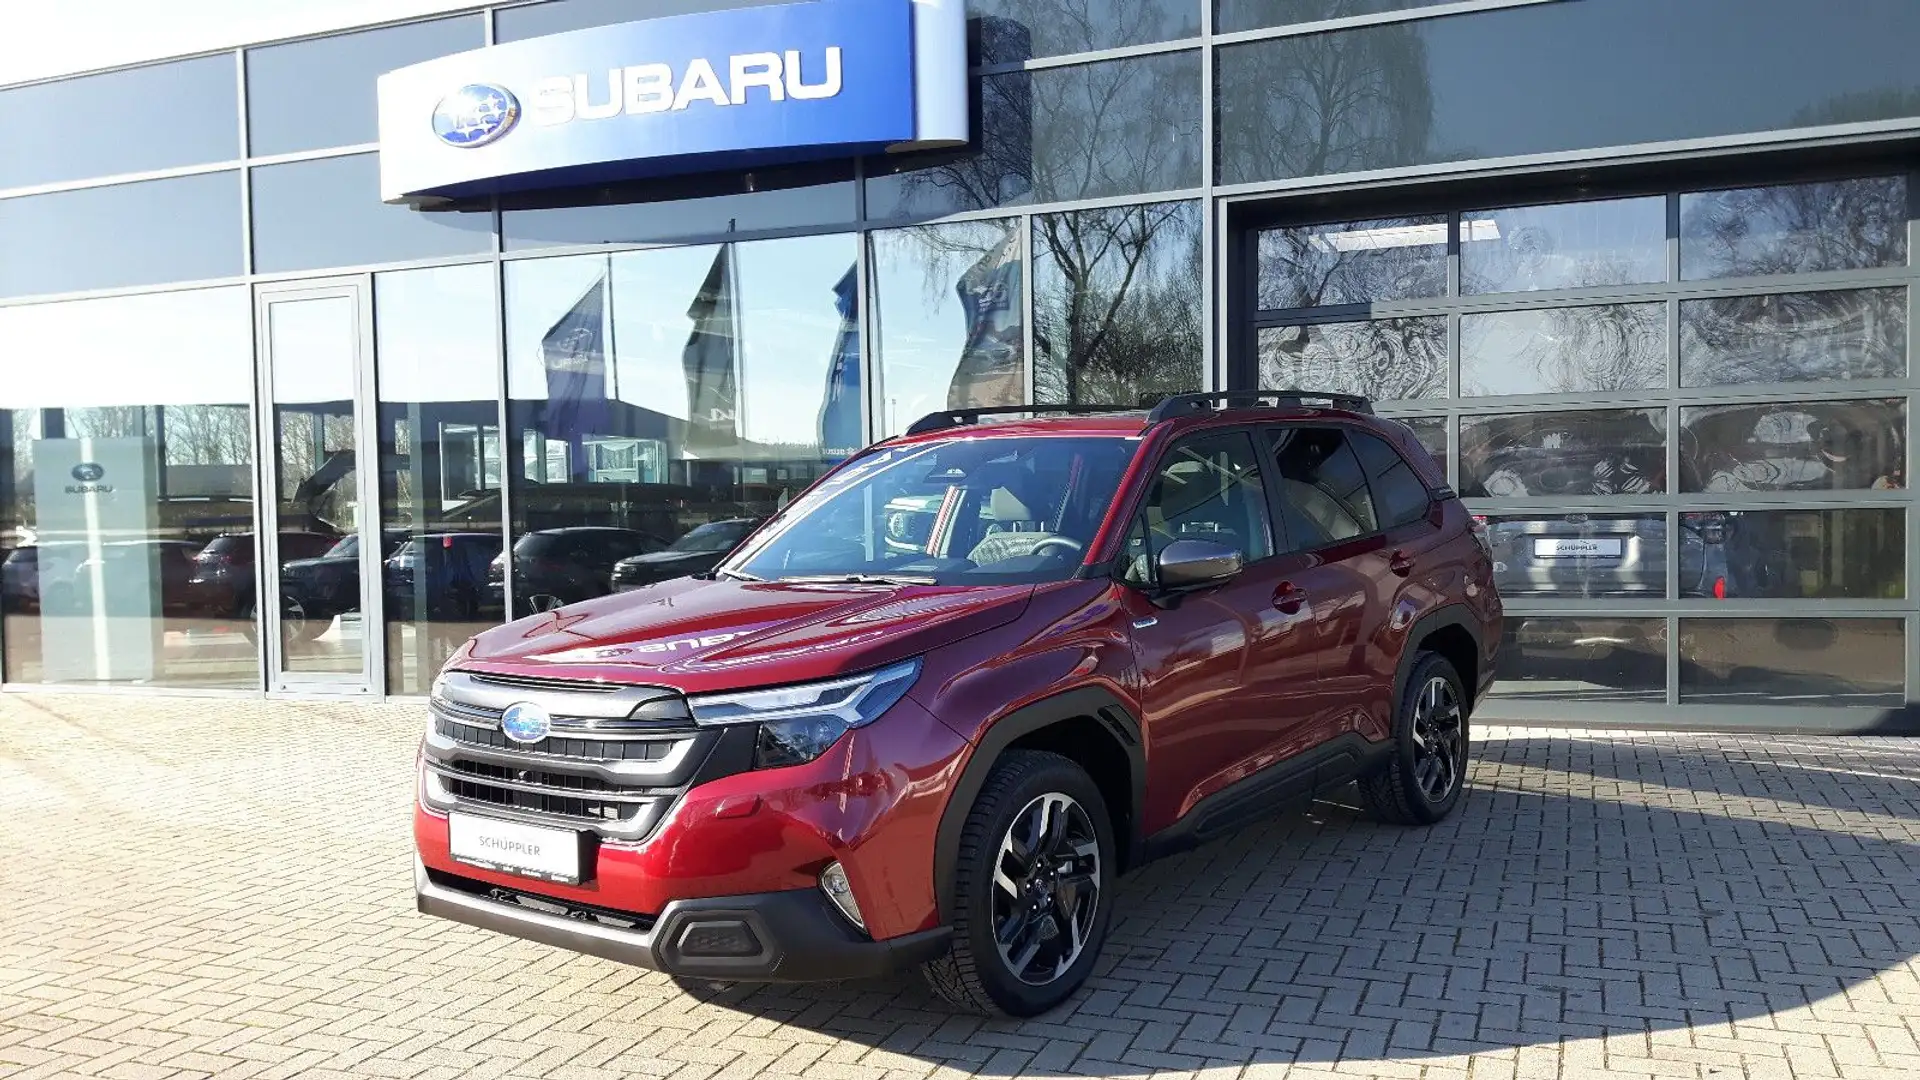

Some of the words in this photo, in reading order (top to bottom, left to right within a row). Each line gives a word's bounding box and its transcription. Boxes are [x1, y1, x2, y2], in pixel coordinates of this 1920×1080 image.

[530, 46, 842, 127] SUBARU
[64, 484, 113, 494] SUBARU
[479, 835, 541, 856] SCHÜPPLER
